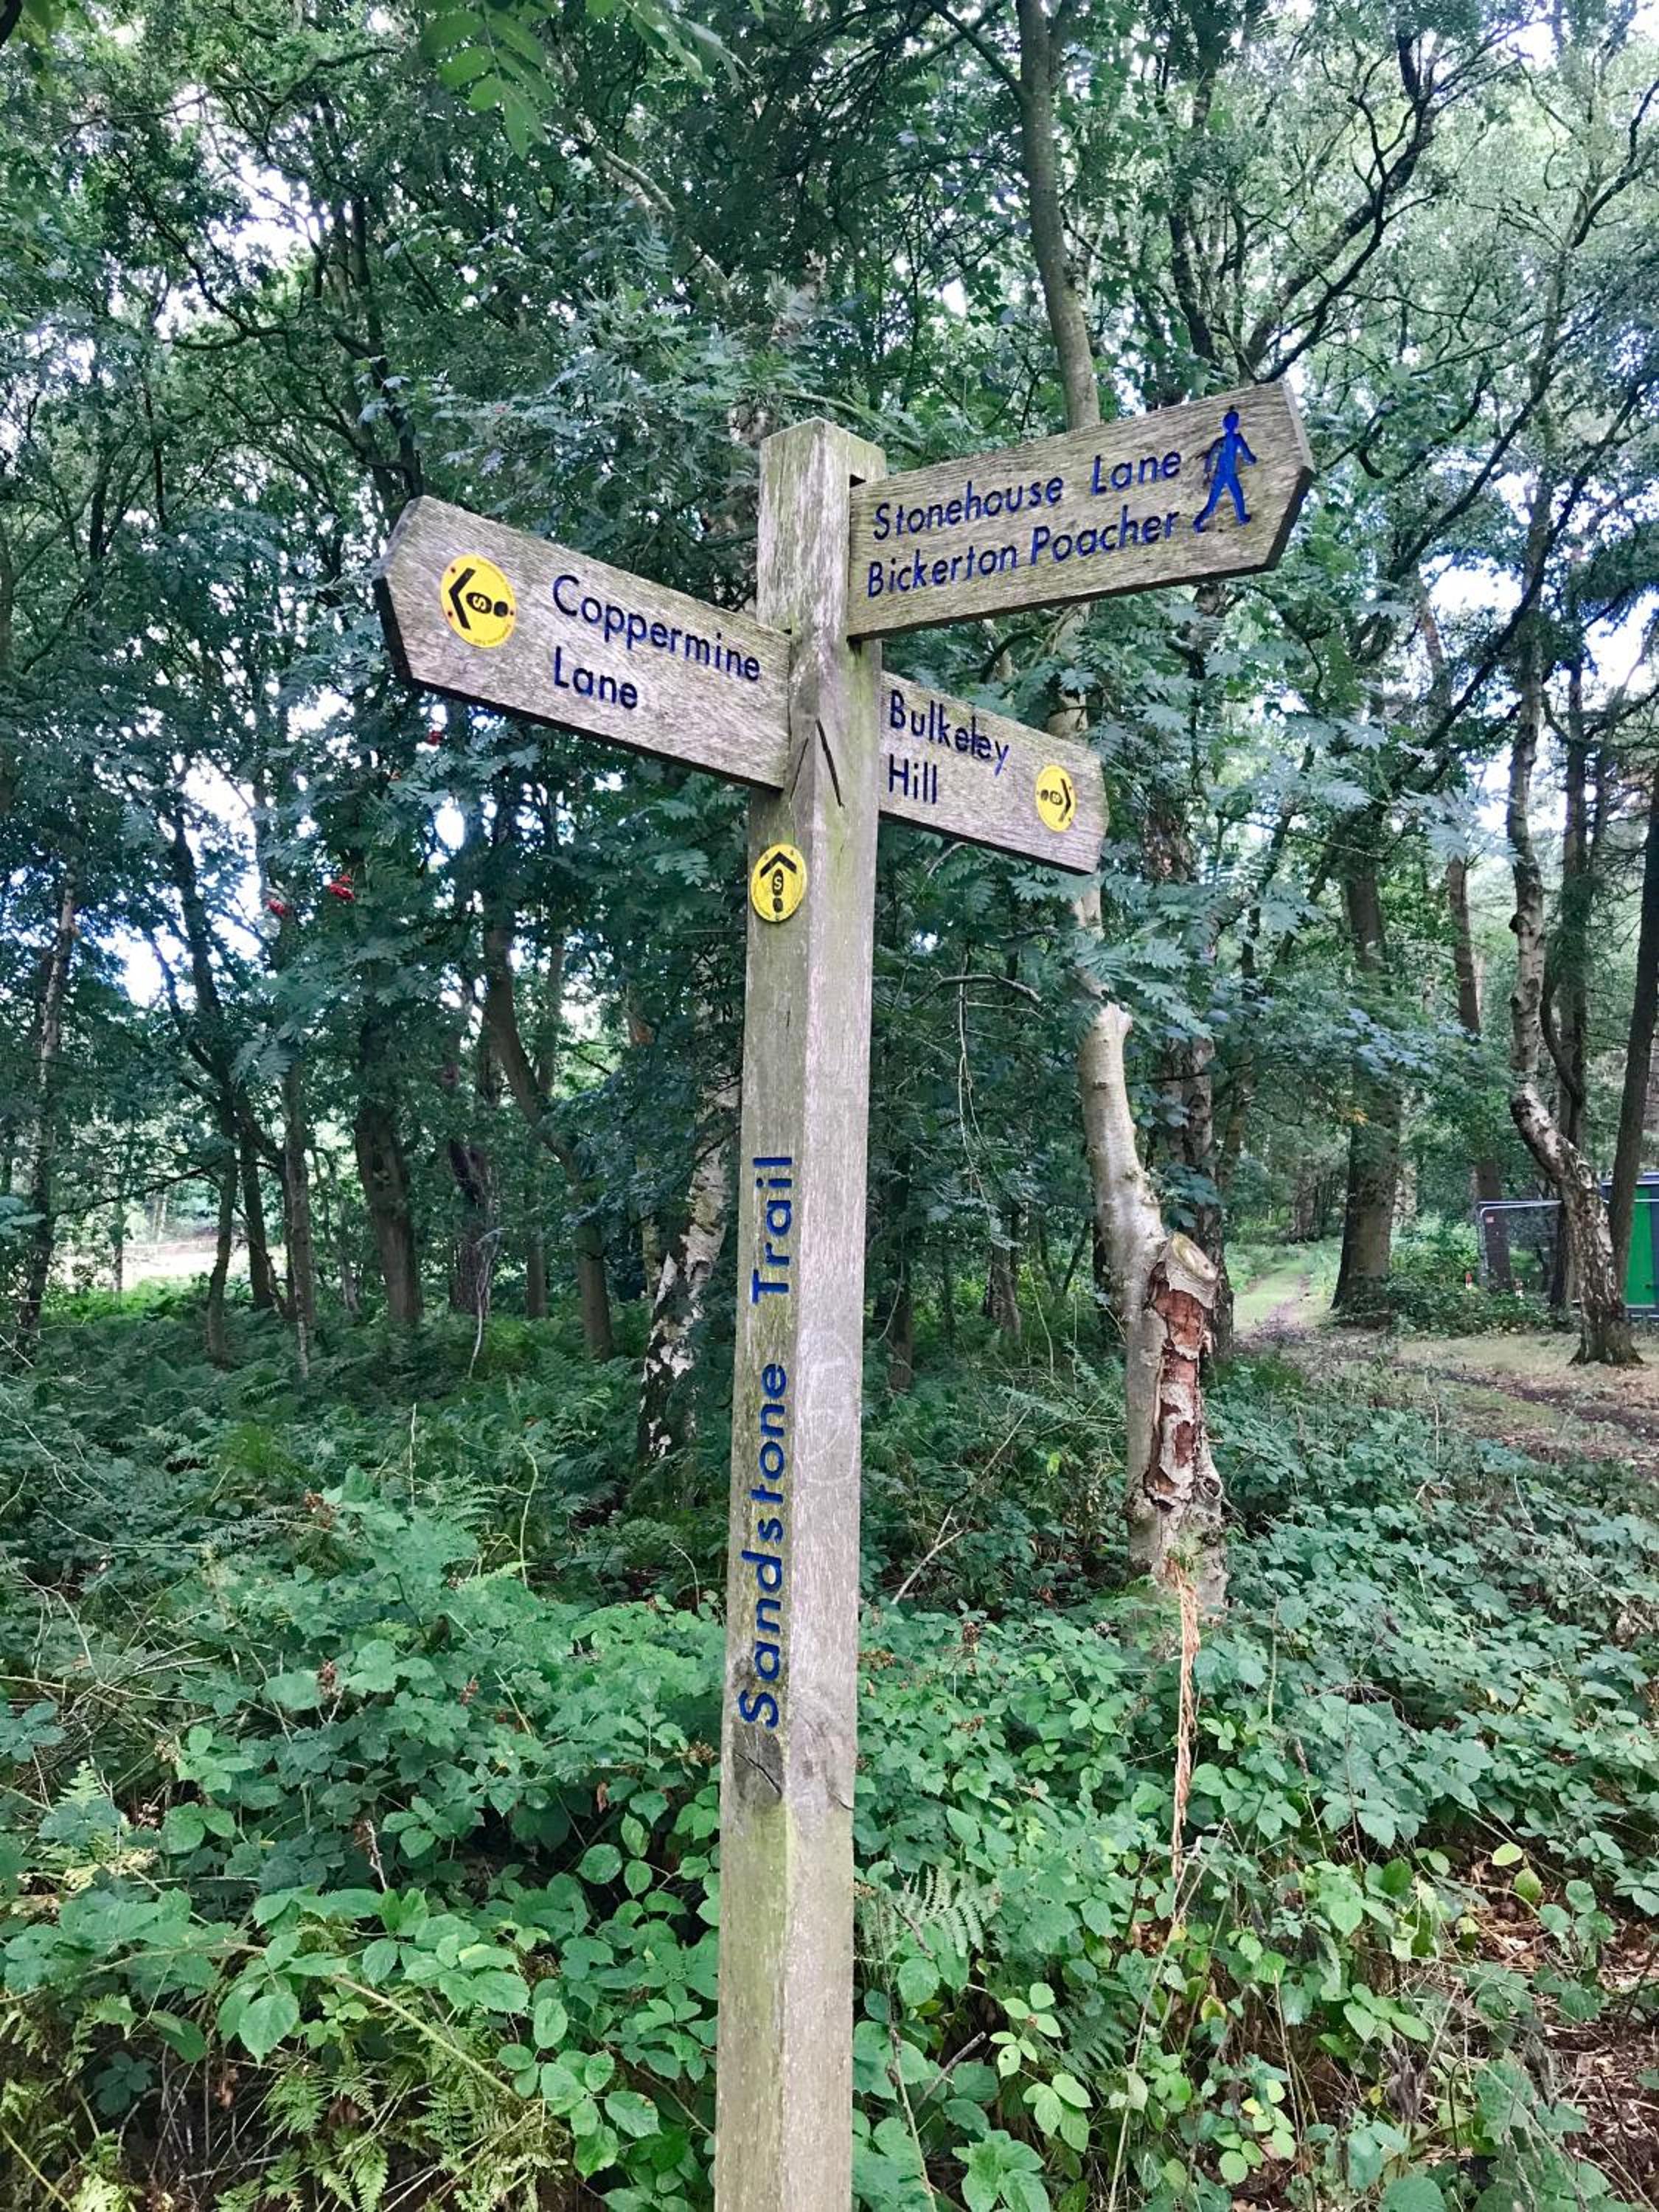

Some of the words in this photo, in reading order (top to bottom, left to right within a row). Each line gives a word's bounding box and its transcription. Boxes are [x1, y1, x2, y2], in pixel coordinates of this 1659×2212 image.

[873, 476, 1064, 541] Stonehouse
[1091, 451, 1182, 496] Lane
[868, 544, 1018, 598] Bickerton
[1031, 504, 1180, 566] Poacher
[552, 574, 761, 681] Coppermine
[554, 646, 639, 710] Lane
[890, 689, 1009, 776] Bulkeley
[888, 754, 938, 804] Hill
[773, 876, 782, 890] S
[752, 1156, 793, 1304] Trail
[738, 1363, 788, 1730] Sandstone
